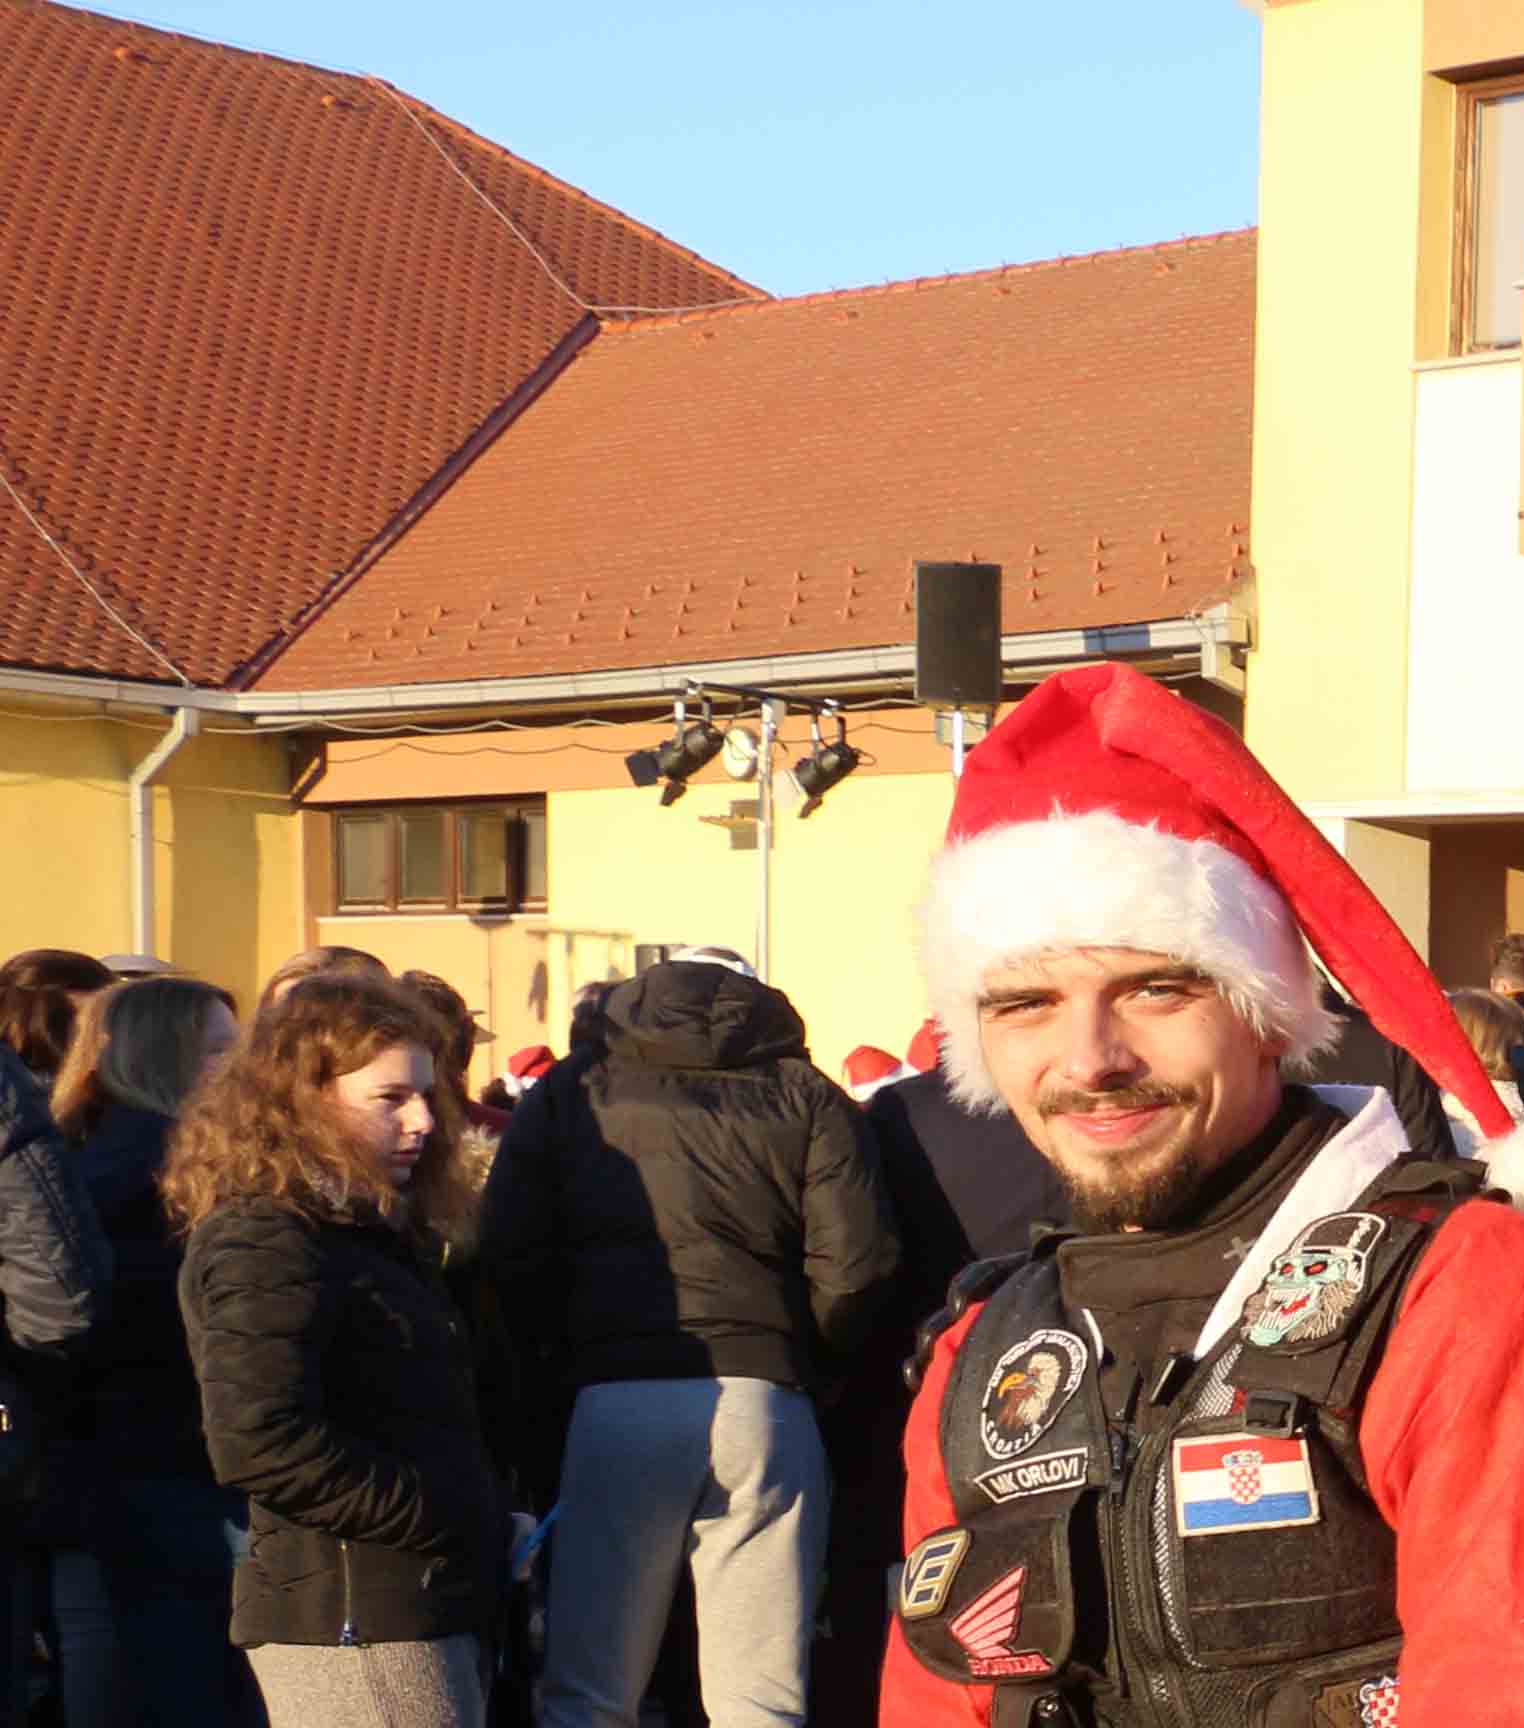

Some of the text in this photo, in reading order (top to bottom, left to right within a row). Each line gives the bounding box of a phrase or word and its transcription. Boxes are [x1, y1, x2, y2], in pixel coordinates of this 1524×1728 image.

[986, 1420, 1042, 1453] CROATIA
[990, 1457, 1079, 1495] MK ORLOVI
[968, 1652, 1054, 1676] HONDA
